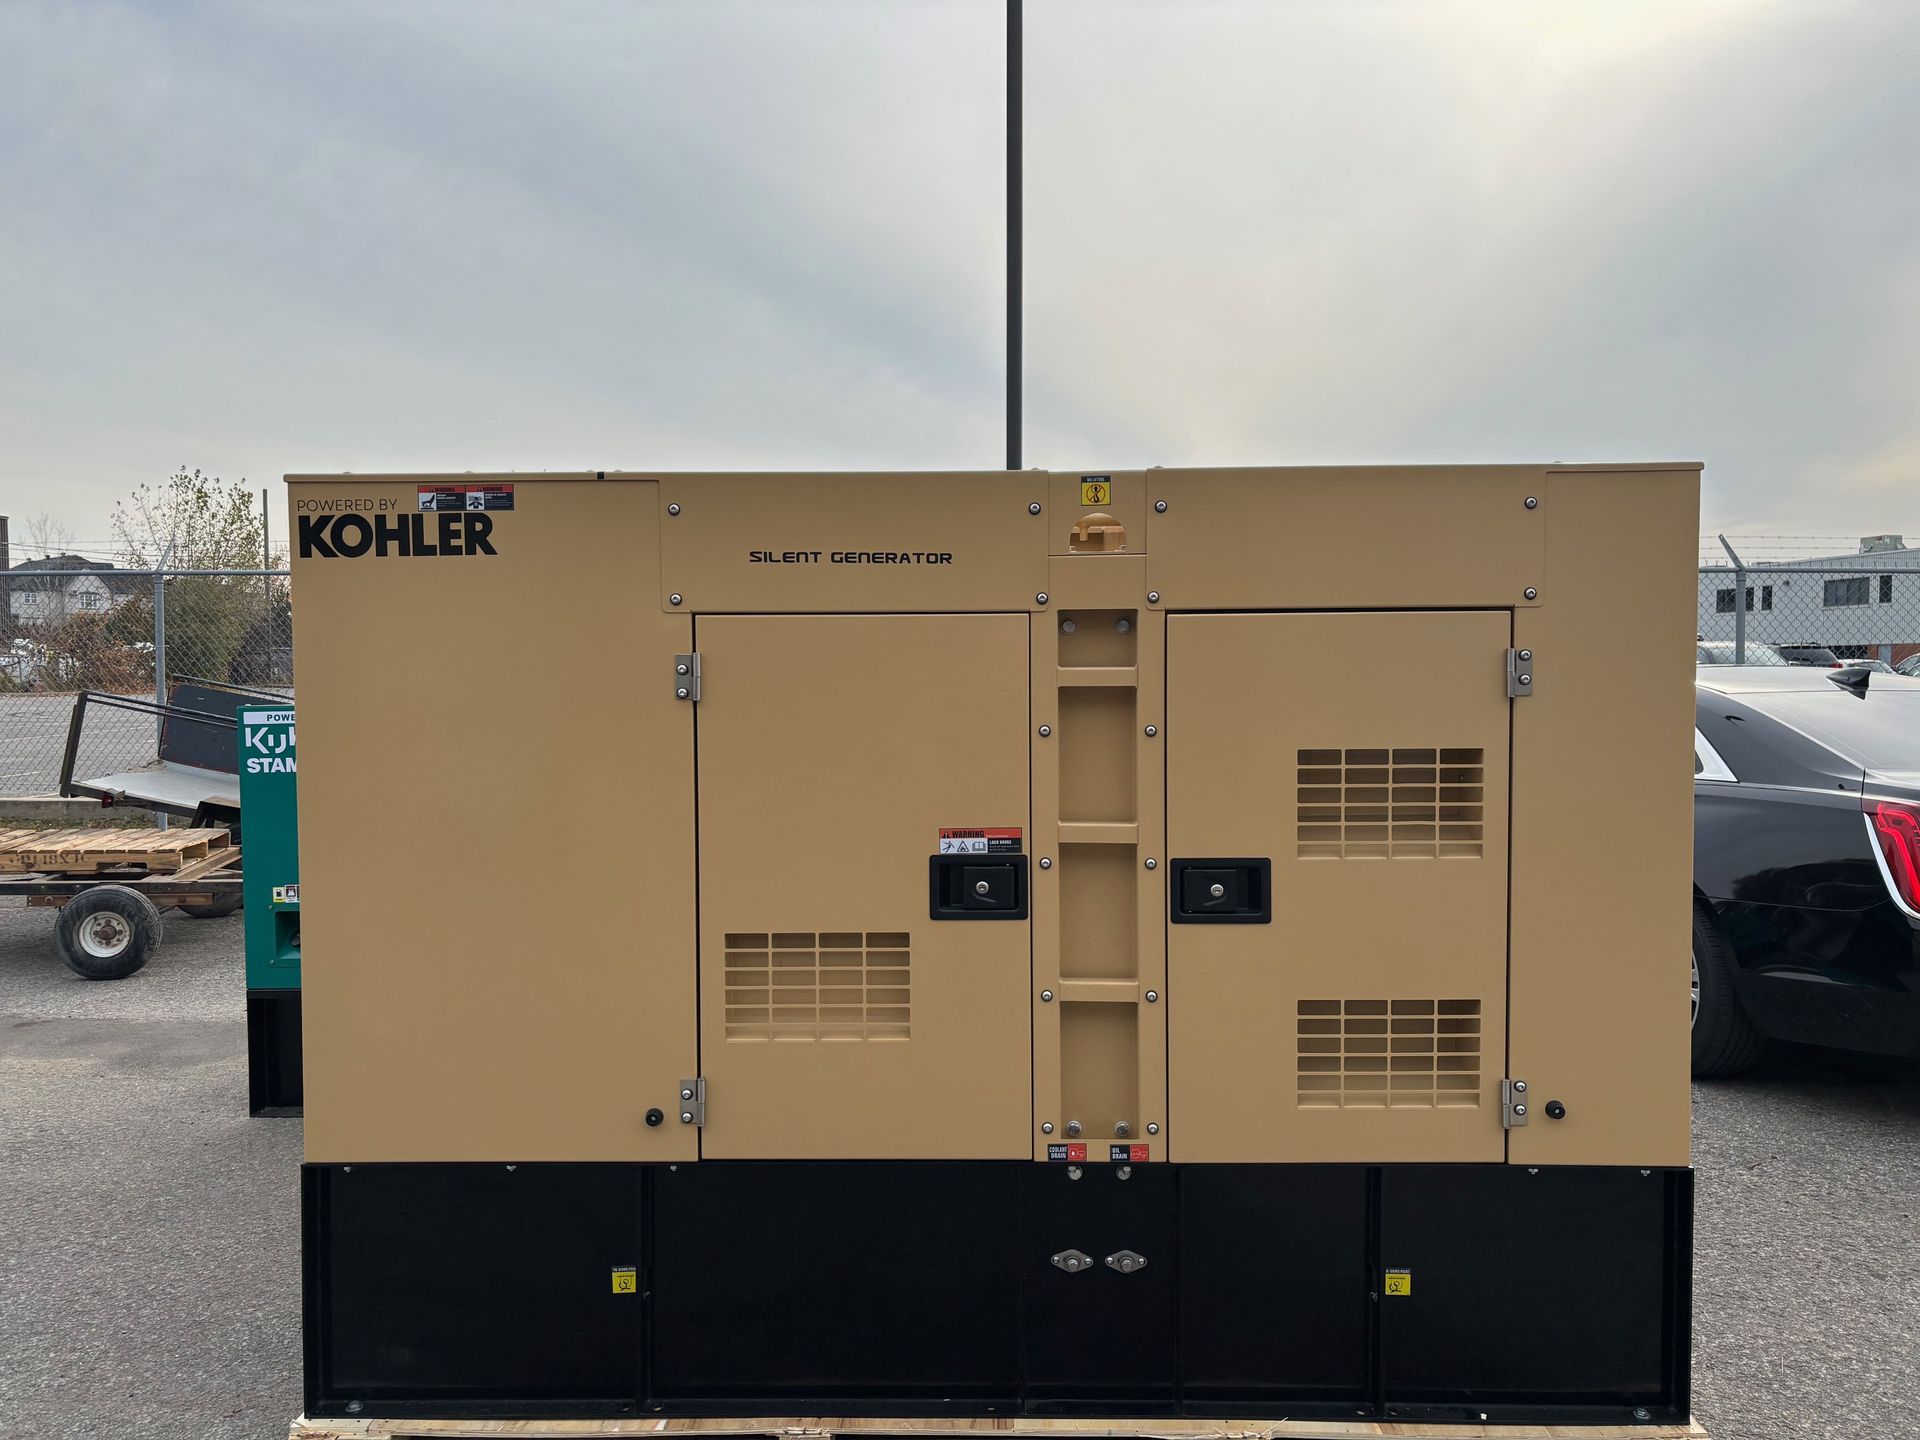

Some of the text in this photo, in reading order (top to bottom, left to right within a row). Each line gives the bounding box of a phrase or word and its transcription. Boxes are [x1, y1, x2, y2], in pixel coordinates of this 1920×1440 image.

[297, 498, 398, 512] POWERED BY
[298, 512, 498, 558] KOHLER
[749, 551, 953, 564] SILENT GENERATOR
[952, 830, 985, 838] WARNING
